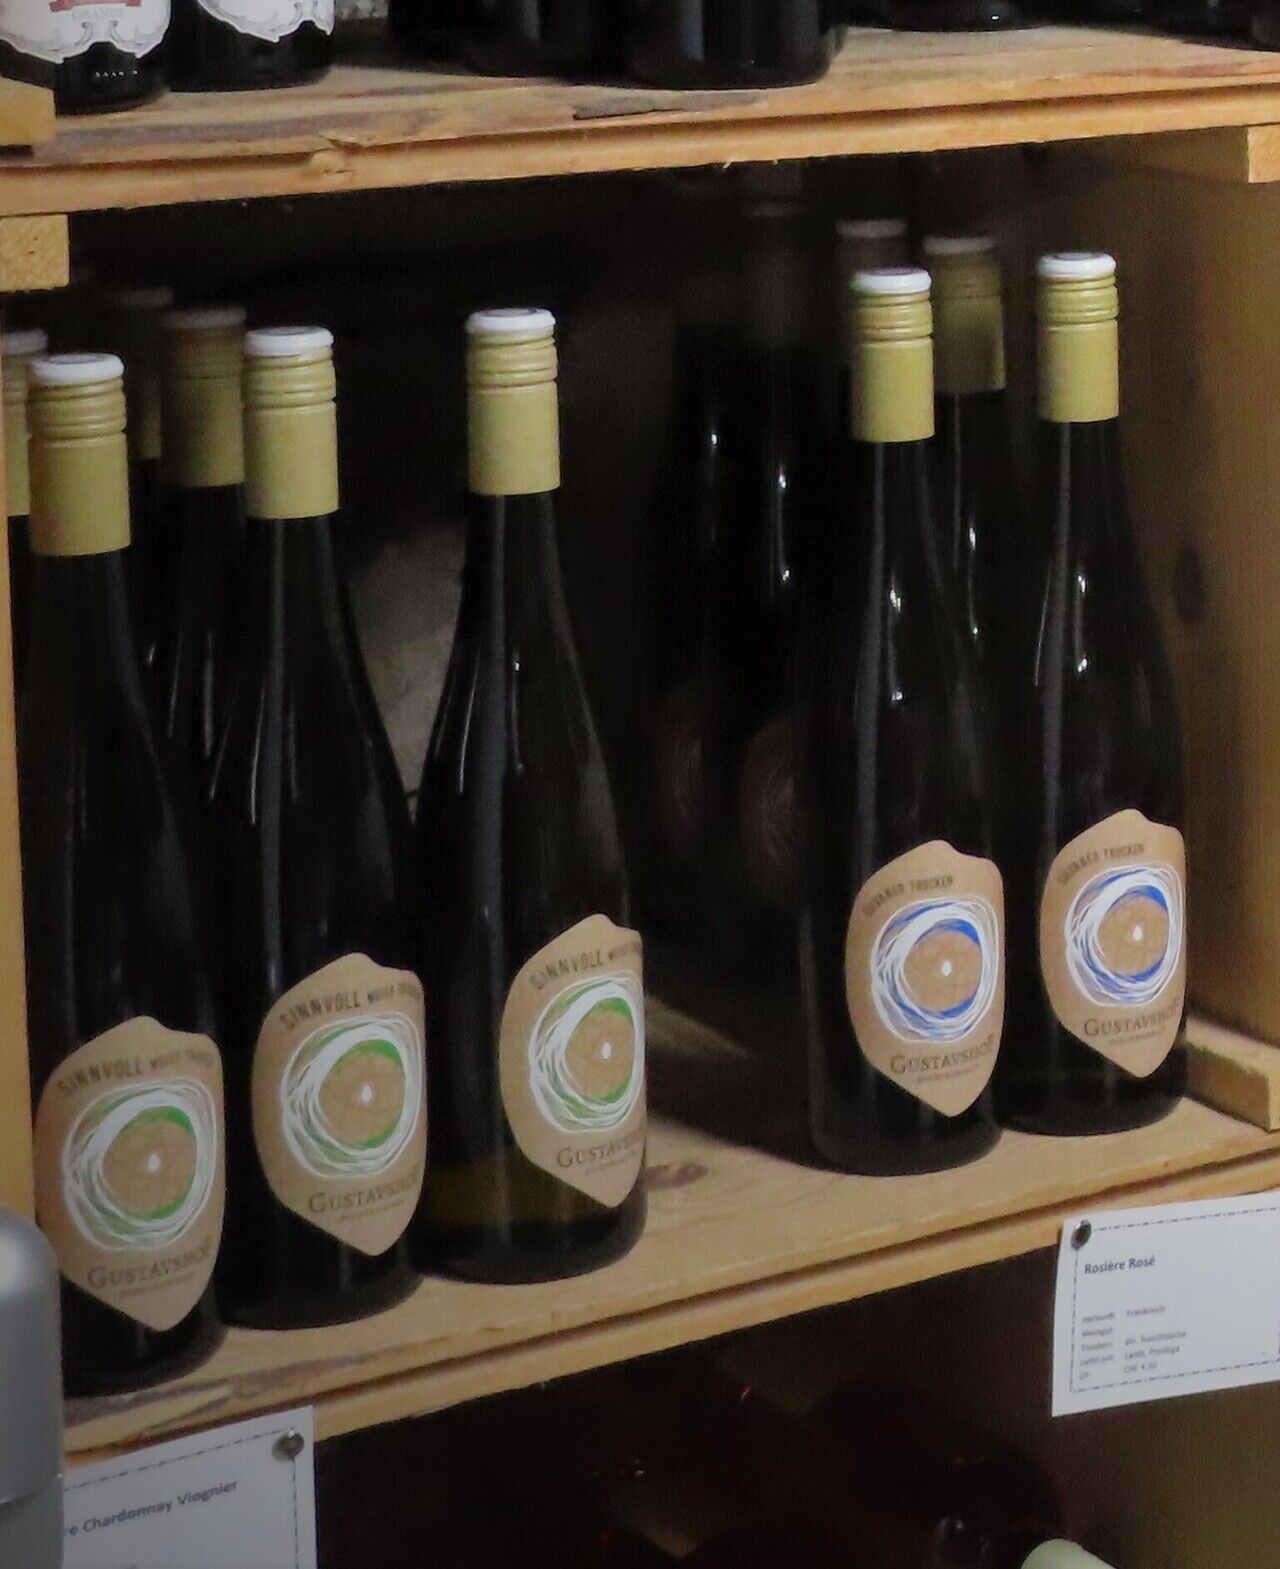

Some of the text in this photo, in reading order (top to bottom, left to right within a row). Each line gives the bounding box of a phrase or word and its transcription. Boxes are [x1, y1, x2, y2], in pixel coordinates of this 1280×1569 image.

[1084, 1254, 1156, 1275] Rosière Rosé
[83, 1500, 173, 1533] Chardonnay
[177, 1480, 239, 1506] Viognier
